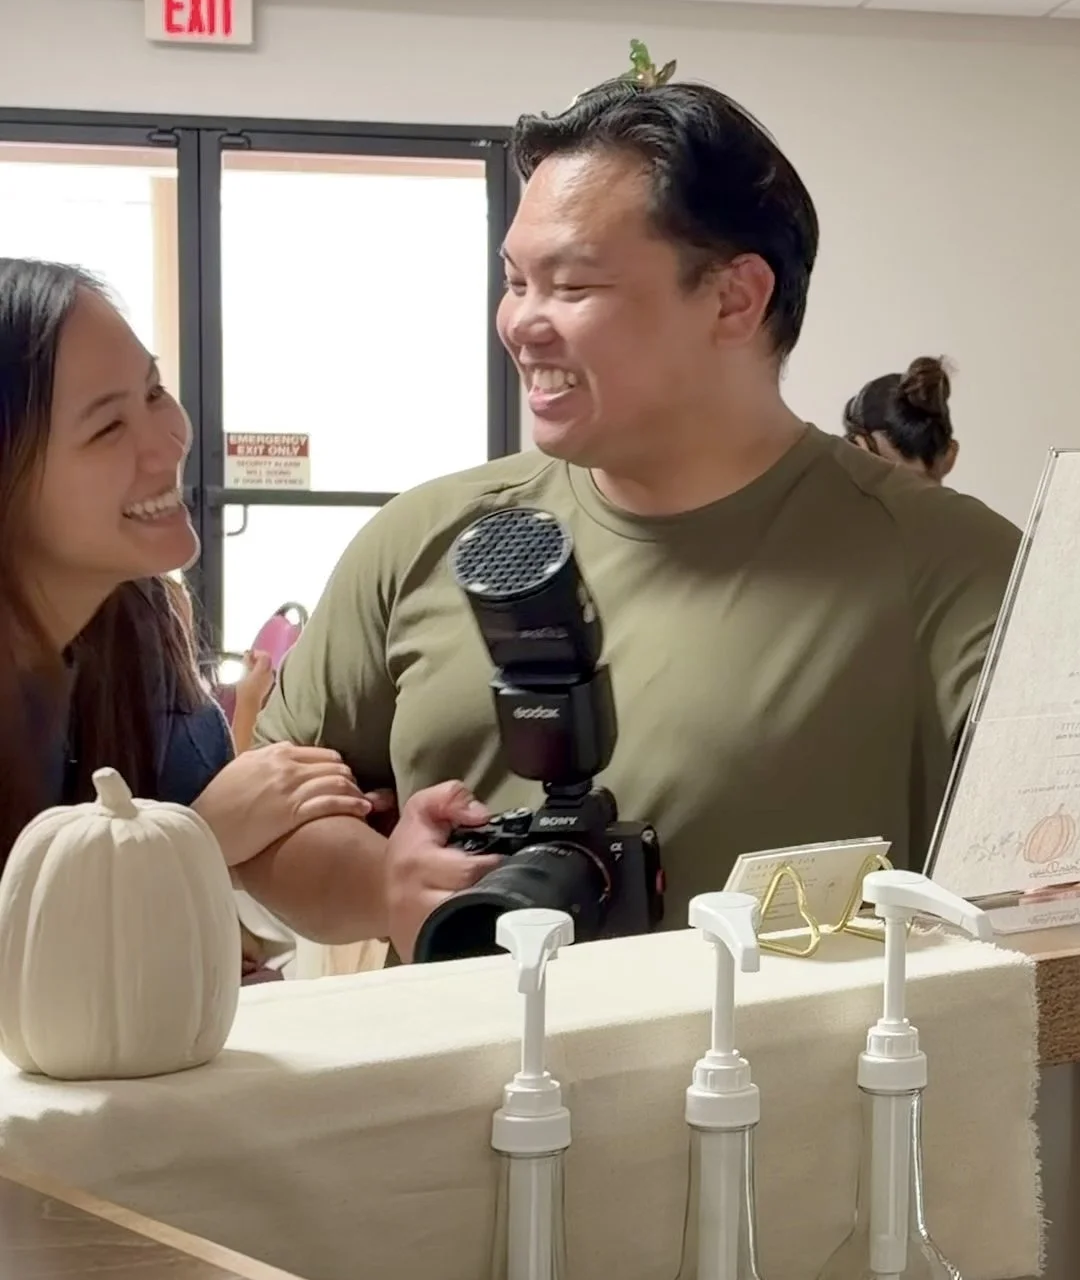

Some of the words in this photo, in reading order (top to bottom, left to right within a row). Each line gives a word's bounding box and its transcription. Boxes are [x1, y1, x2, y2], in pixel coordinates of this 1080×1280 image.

[229, 434, 307, 445] EMERGENCY
[237, 445, 264, 456] EXIT
[268, 445, 300, 456] ONLY
[539, 816, 579, 827] SONY
